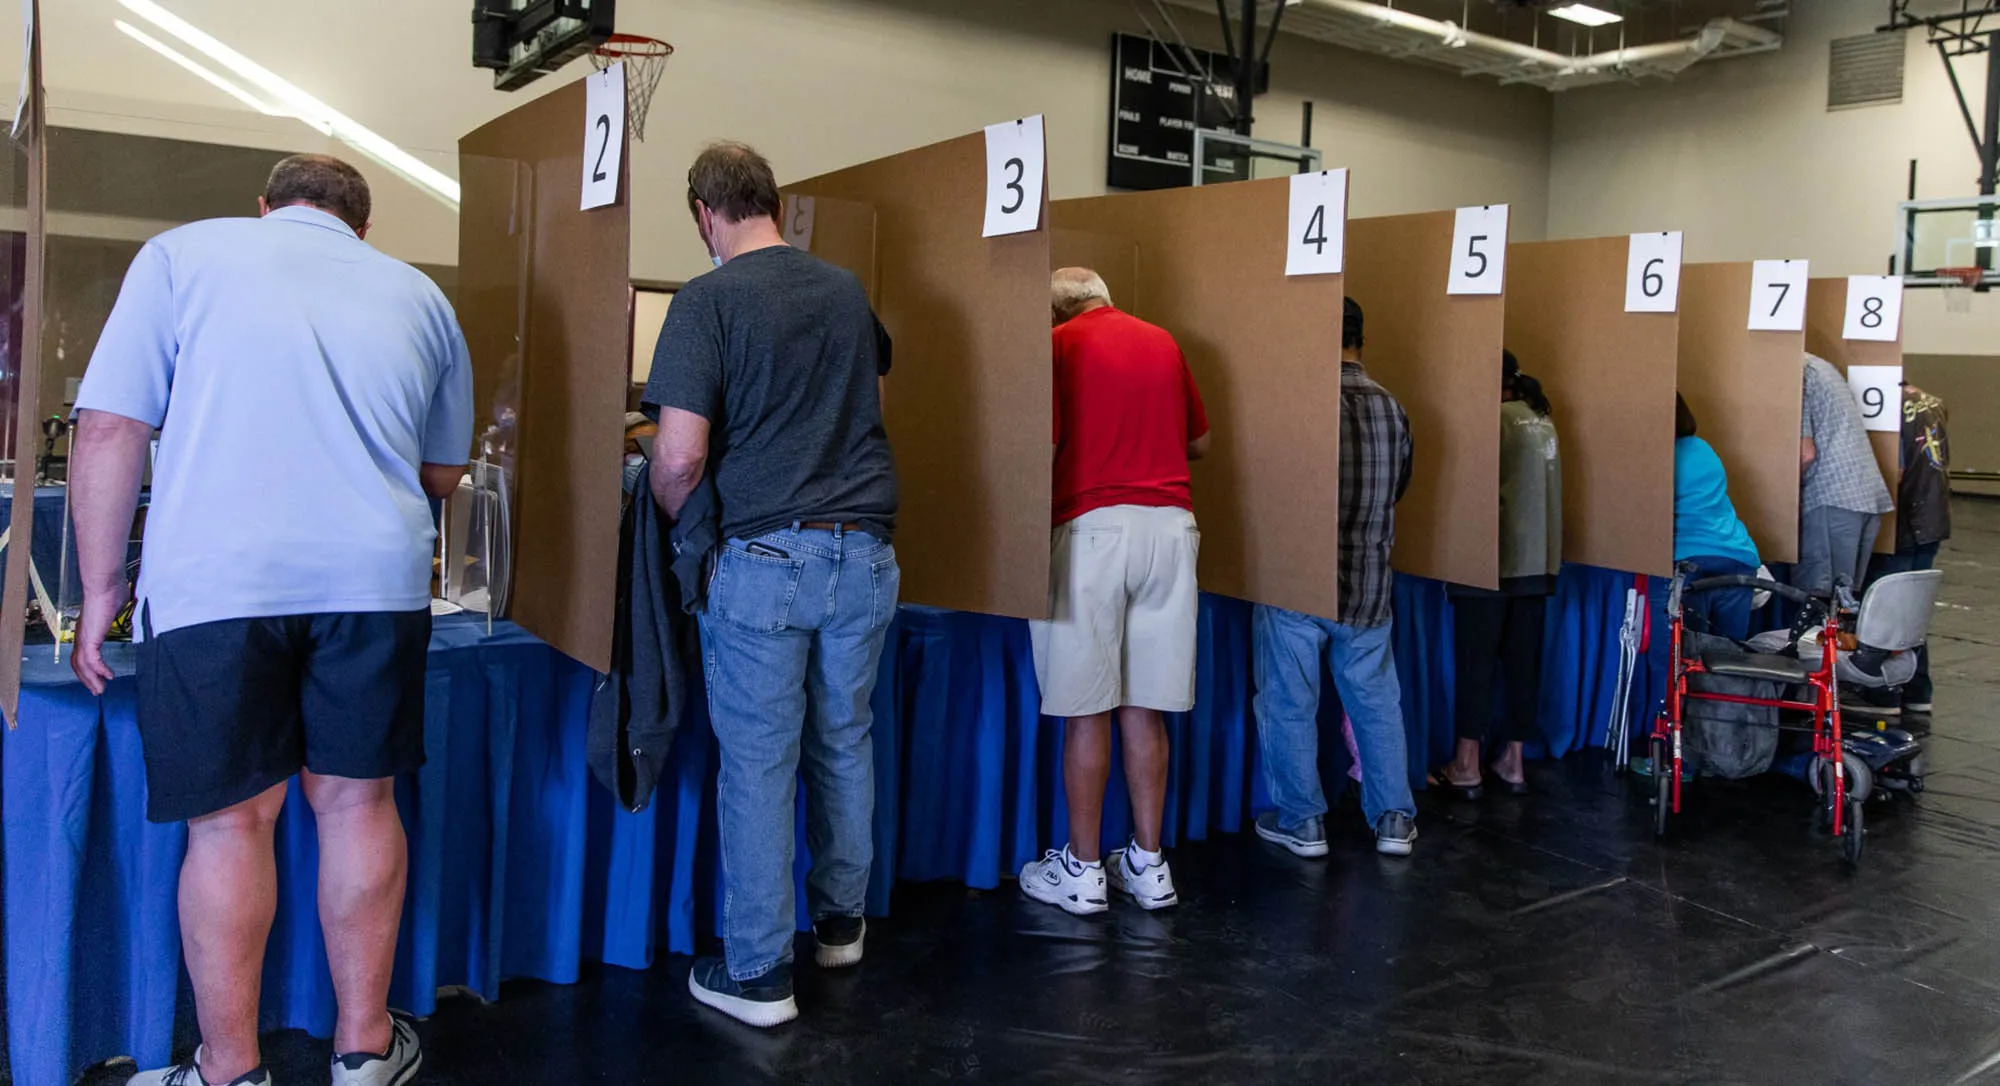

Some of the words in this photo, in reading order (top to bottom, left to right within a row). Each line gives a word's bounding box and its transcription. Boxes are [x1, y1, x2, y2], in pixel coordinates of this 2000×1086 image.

[1125, 67, 1152, 84] HOME
[1159, 117, 1183, 129] PLAYER
[592, 114, 611, 183] 2
[1002, 157, 1024, 214] 3
[1303, 204, 1328, 255] 4
[1465, 235, 1487, 278] 5
[1642, 258, 1664, 298] 6
[1768, 283, 1790, 317] 7
[1860, 297, 1883, 328] 8
[1862, 387, 1884, 419] 9
